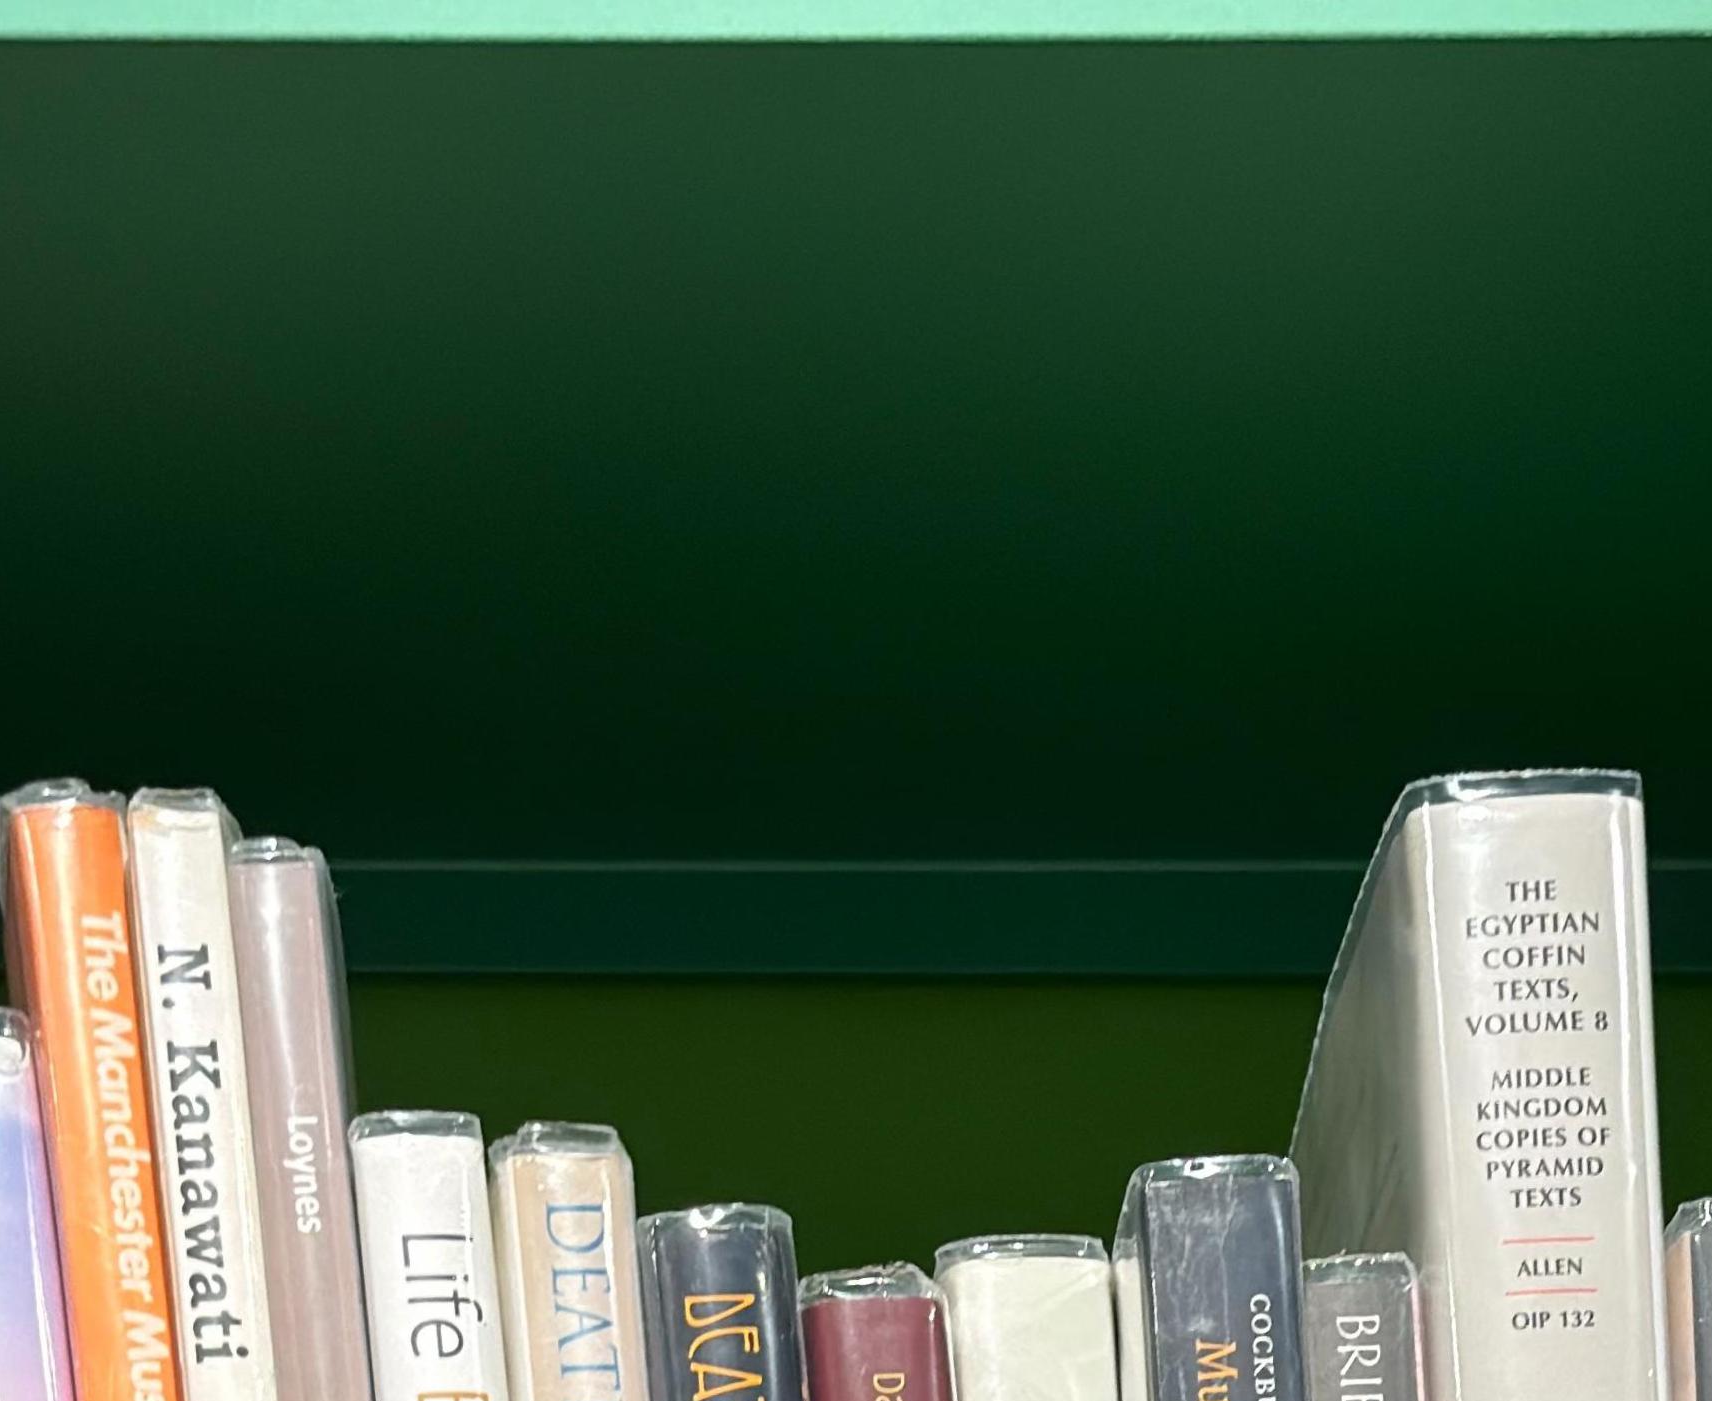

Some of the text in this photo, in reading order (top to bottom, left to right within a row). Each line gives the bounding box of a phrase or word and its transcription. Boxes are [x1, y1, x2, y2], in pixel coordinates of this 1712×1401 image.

[1505, 880, 1557, 902] THE
[1465, 912, 1600, 939] EGYPTIAN
[81, 911, 128, 998] The
[1482, 945, 1585, 970] COFFIN
[156, 944, 212, 1010] N.
[1493, 979, 1579, 1004] TEXTS,
[1465, 1010, 1608, 1037] VOLUME 8
[1490, 1066, 1592, 1090] MIDDLE
[1475, 1096, 1608, 1121] KINGDOM
[1475, 1126, 1611, 1152] COPIES OF
[92, 1007, 153, 1301] Manchester
[284, 1114, 323, 1235] Loynes
[1486, 1157, 1604, 1181] PYRAMID
[166, 1039, 249, 1366] Kanawati
[1509, 1186, 1582, 1209] TEXTS
[1516, 1257, 1583, 1278] ALLEN
[400, 1232, 484, 1360] Life
[1511, 1309, 1596, 1331] OIP 132
